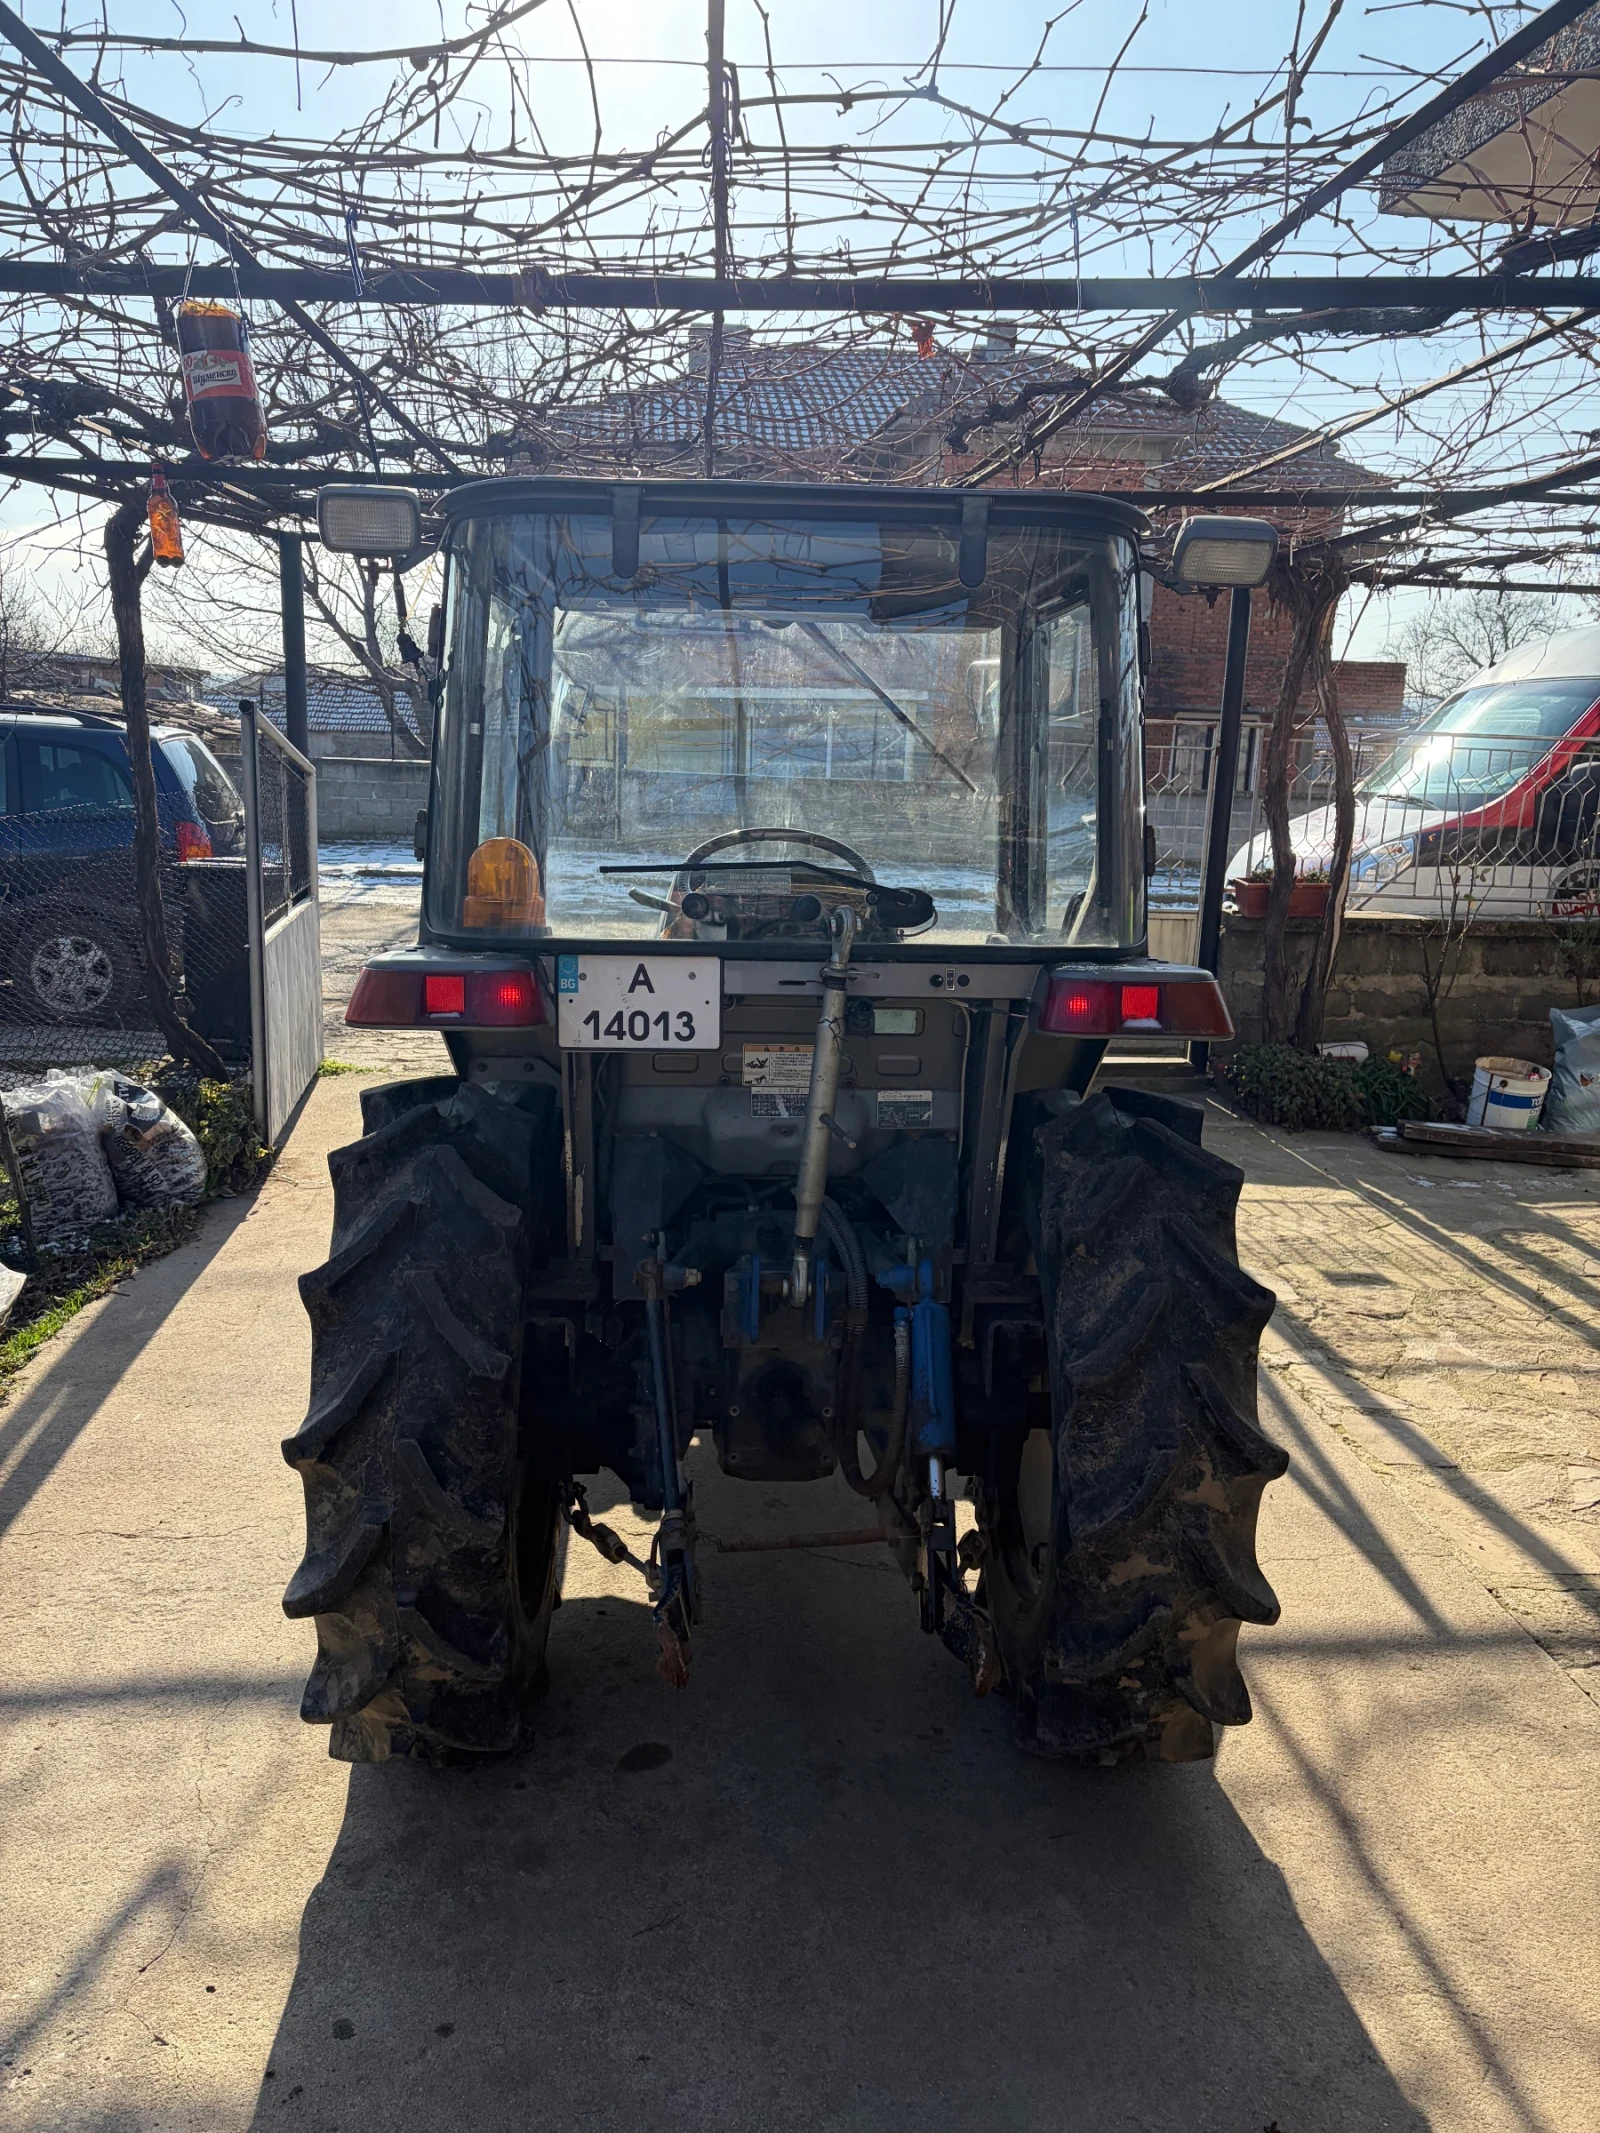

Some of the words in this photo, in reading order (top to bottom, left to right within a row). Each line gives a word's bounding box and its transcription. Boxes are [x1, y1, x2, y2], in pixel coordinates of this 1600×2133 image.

[560, 978, 576, 989] BG
[628, 963, 655, 993] A
[583, 1010, 696, 1042] 14013
